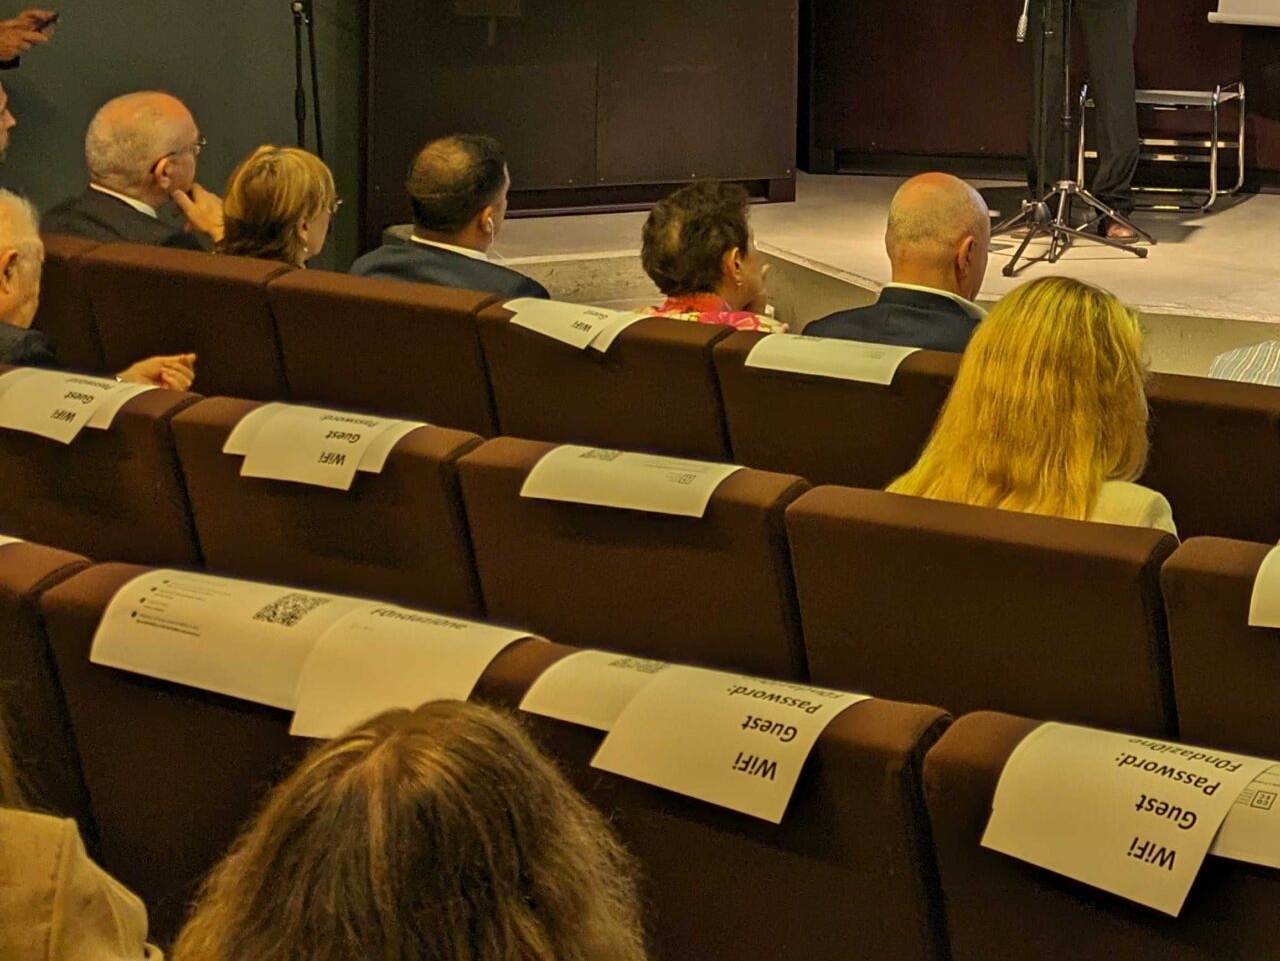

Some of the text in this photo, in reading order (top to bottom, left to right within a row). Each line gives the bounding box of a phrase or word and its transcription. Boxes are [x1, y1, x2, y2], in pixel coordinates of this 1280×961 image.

[325, 430, 362, 445] Guest
[318, 452, 347, 467] WiFi
[727, 684, 823, 715] Password:
[741, 715, 798, 743] Guest
[731, 751, 778, 781] WiFi
[1115, 752, 1222, 797] Password:
[1134, 794, 1198, 831] Guest
[1127, 837, 1177, 871] WiFi
